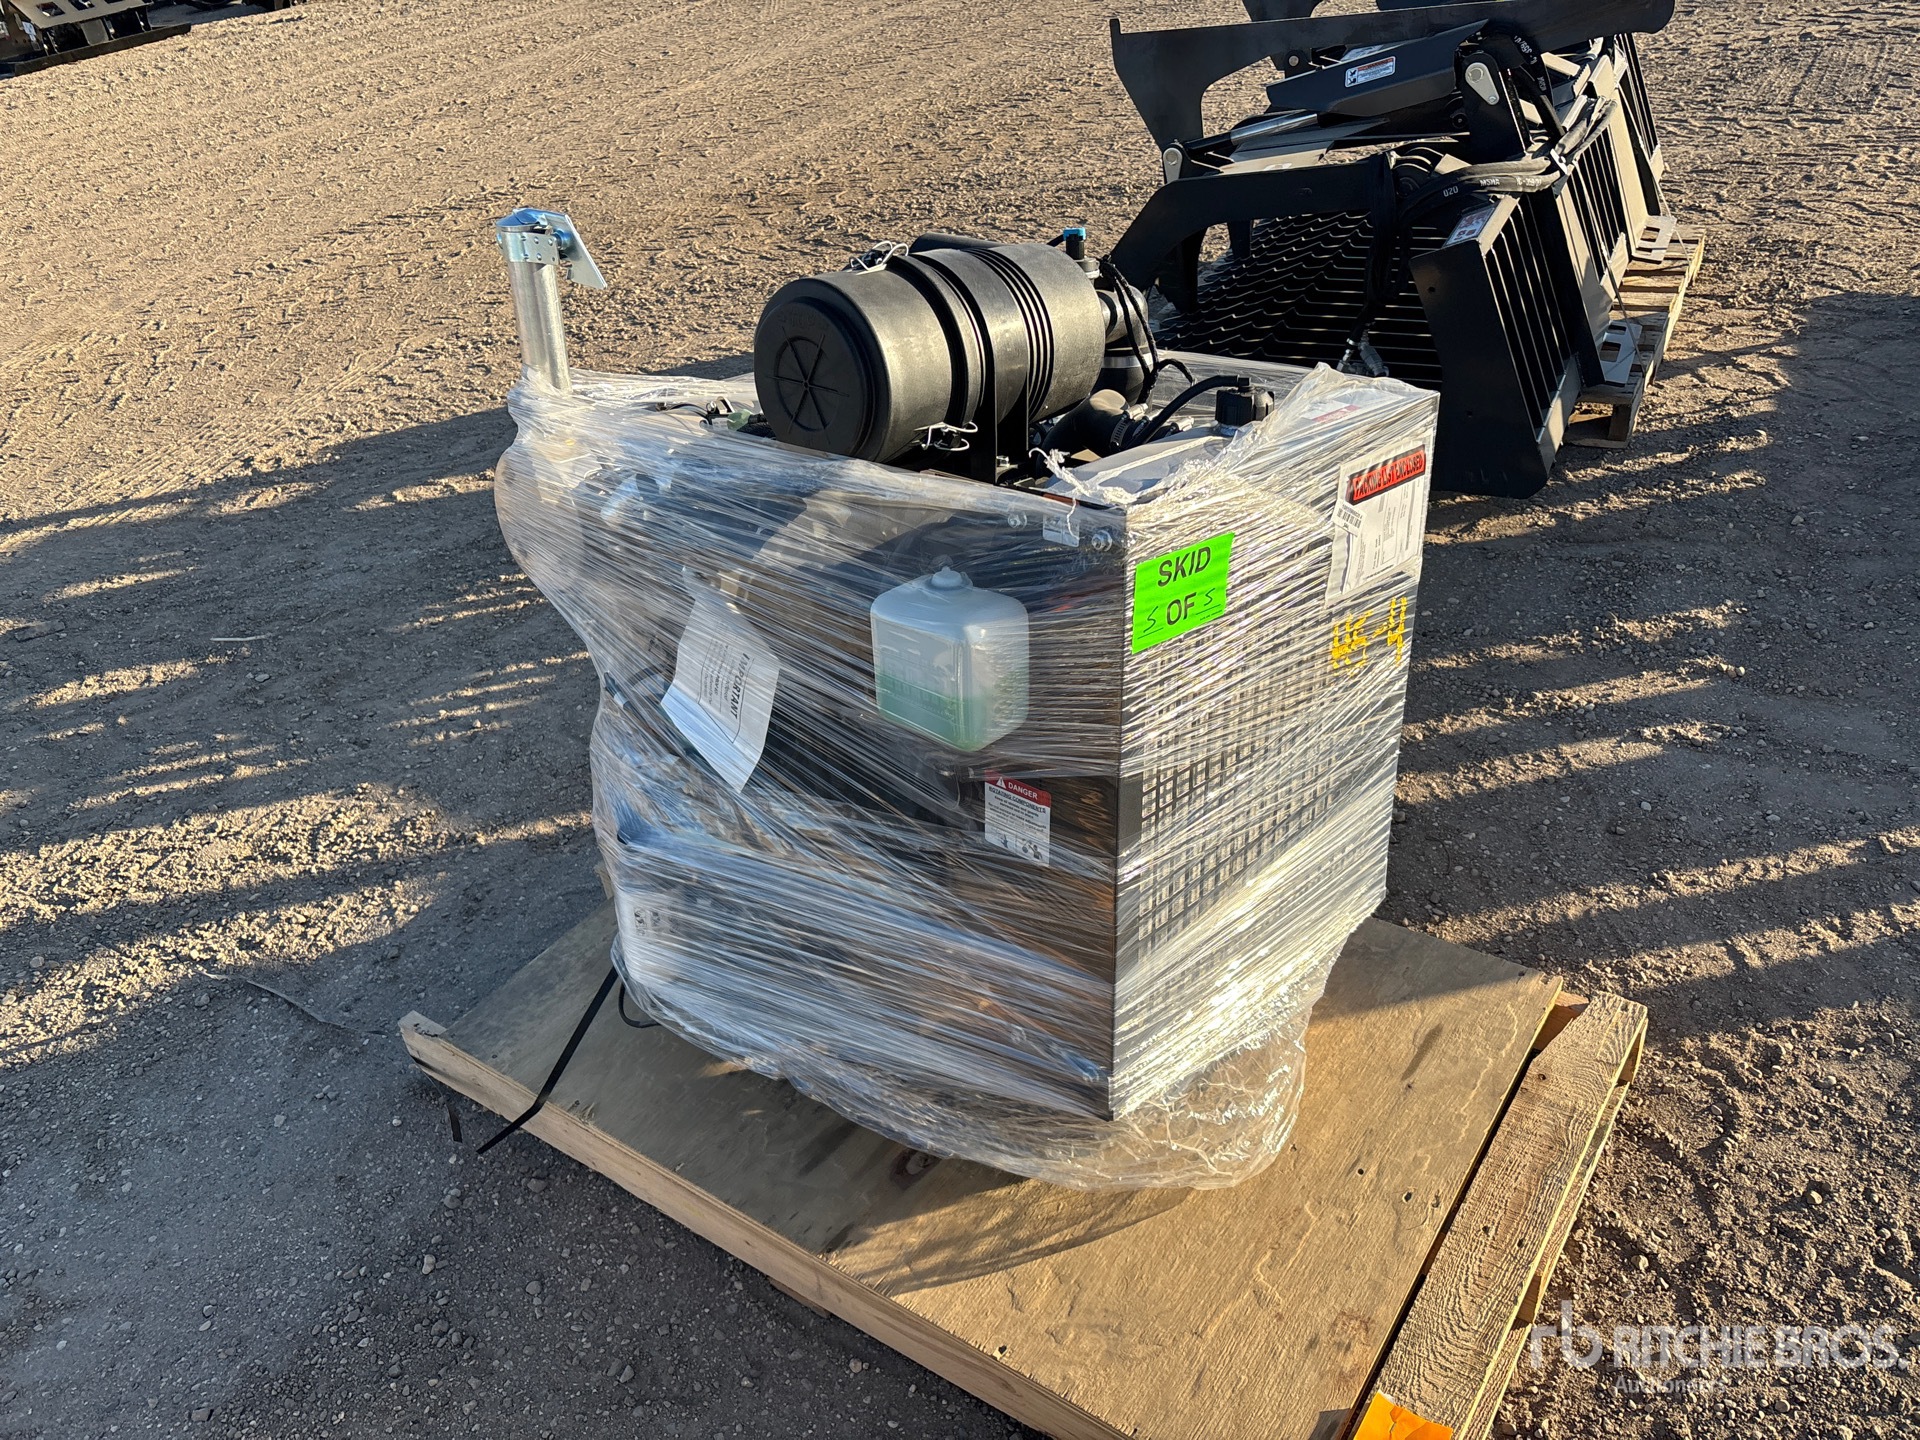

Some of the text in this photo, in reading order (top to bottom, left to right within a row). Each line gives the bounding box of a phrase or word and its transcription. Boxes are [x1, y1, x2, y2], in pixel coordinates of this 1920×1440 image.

[1355, 471, 1382, 498] PACKING
[1381, 465, 1396, 486] LIST
[1157, 546, 1211, 587] SKID
[1166, 591, 1197, 626] OF
[729, 652, 751, 720] IMPORTANT
[1008, 781, 1038, 800] DANGER
